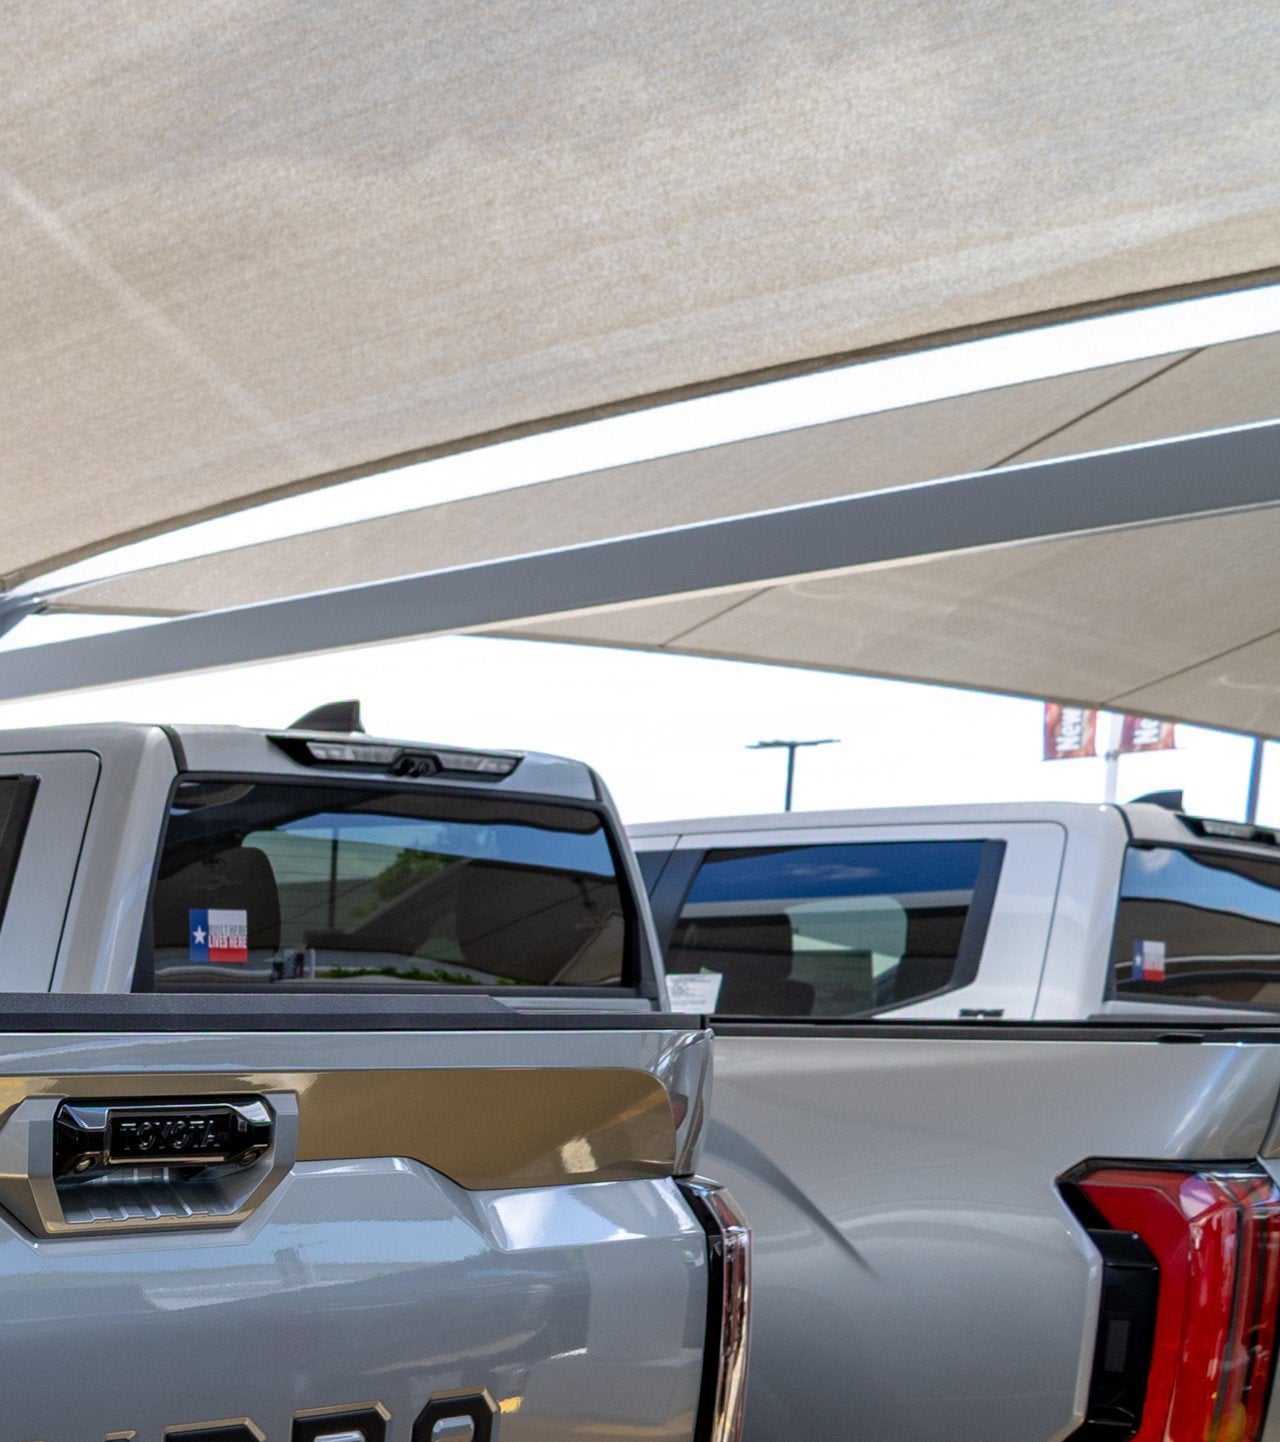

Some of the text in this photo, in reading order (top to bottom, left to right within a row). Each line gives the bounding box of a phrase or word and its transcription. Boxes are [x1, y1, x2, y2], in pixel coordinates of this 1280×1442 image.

[208, 935, 248, 948] LIVES HERE
[119, 1118, 222, 1152] TOYOTA
